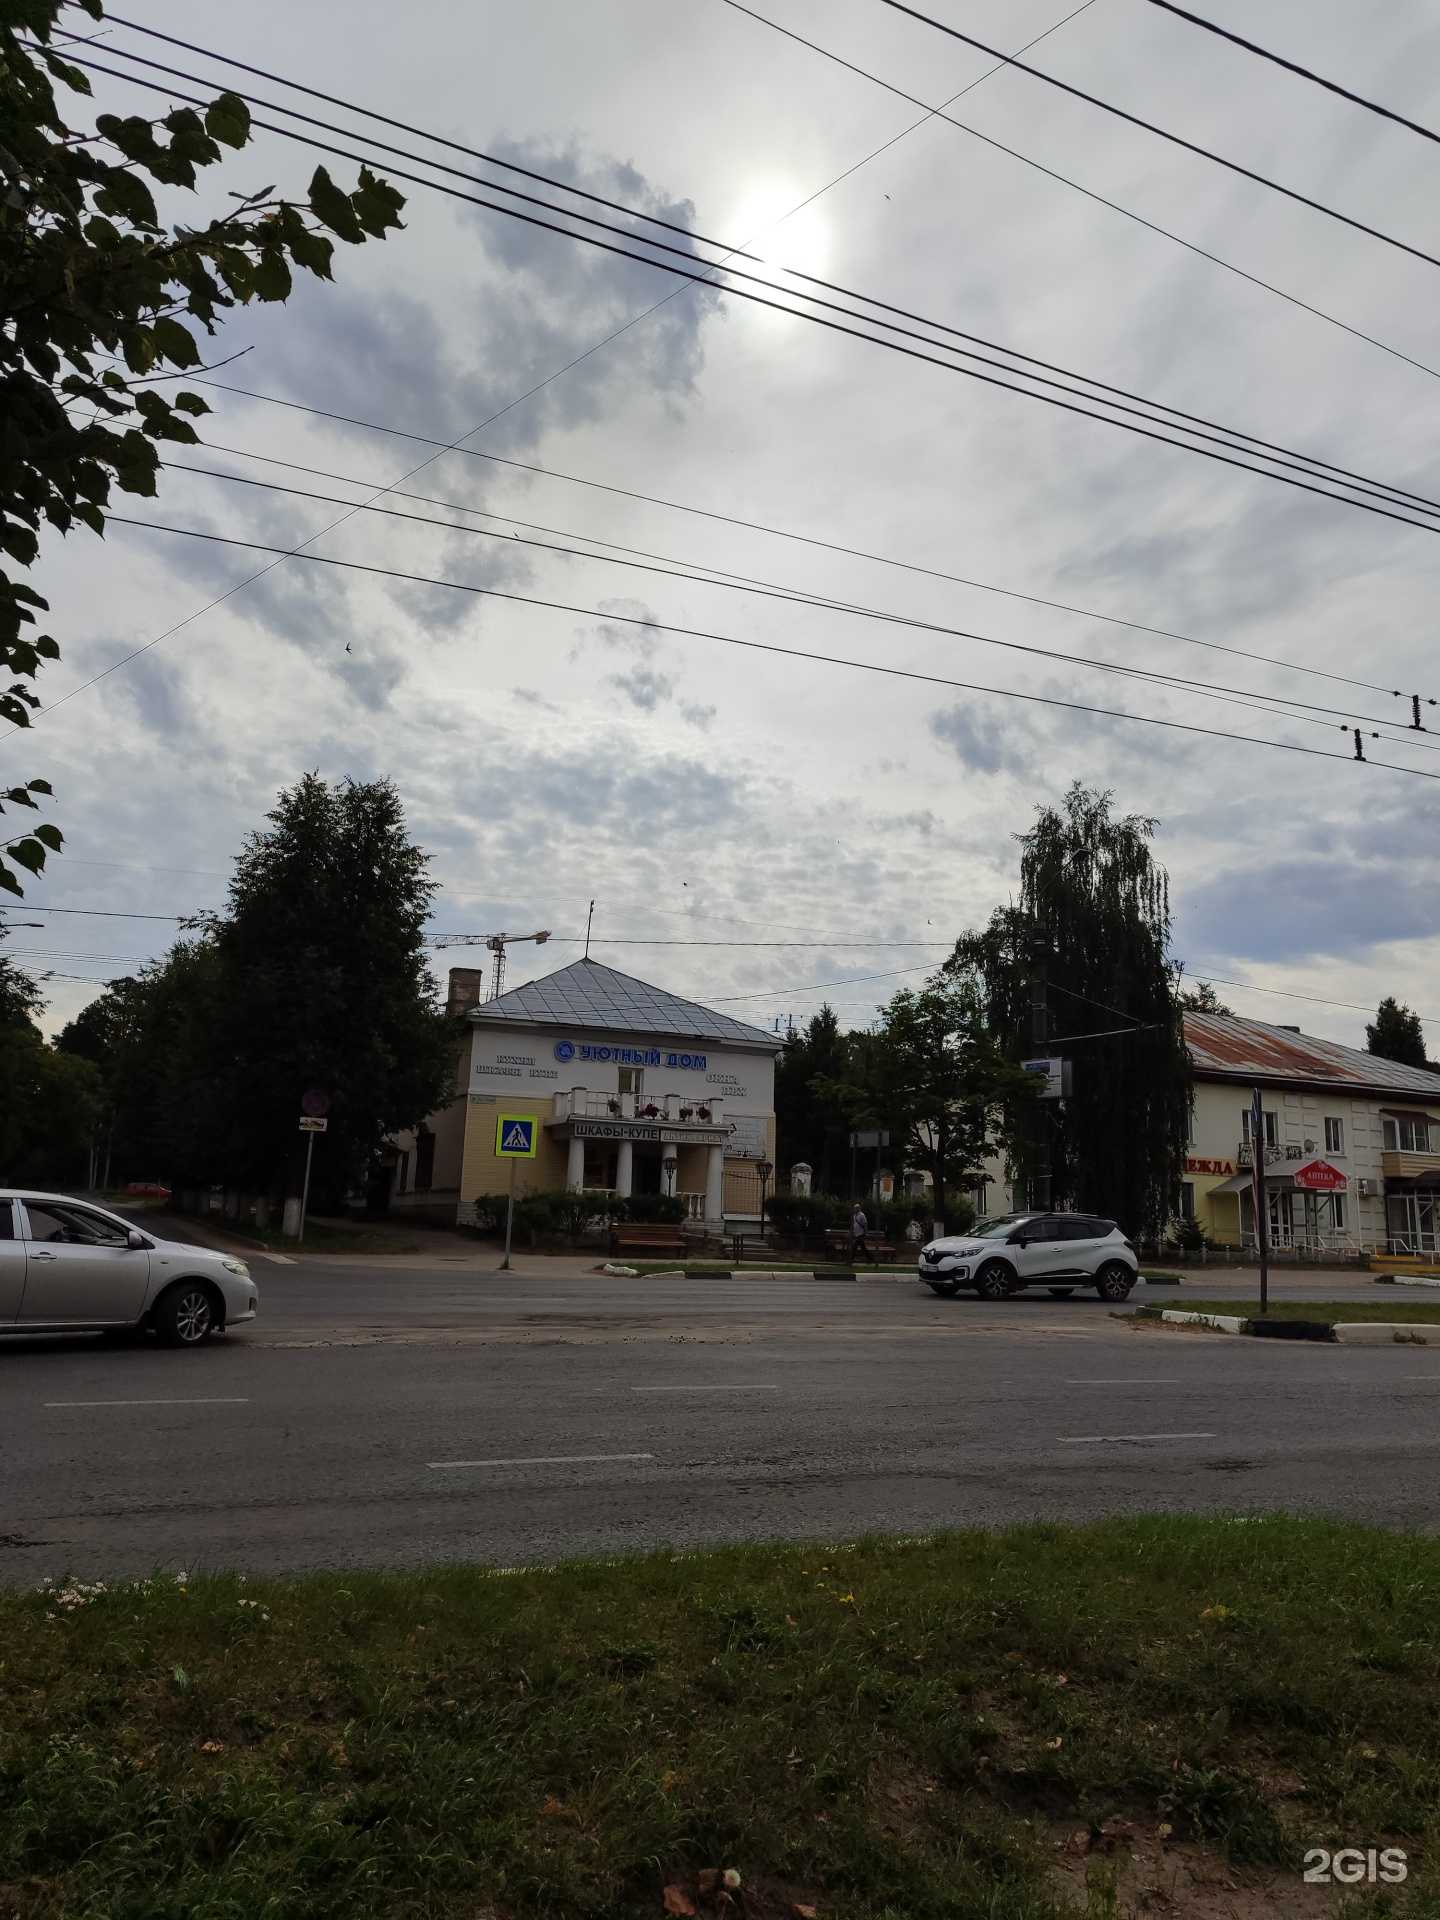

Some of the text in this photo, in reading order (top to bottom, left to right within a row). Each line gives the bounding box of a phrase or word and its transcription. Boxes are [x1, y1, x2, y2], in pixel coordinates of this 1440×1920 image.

[580, 1045, 707, 1070] УЮТНЫЙ ДОМ
[575, 1124, 658, 1139] ШКАФЫ-КУПЕ
[1306, 1171, 1335, 1181] АПТЕКА
